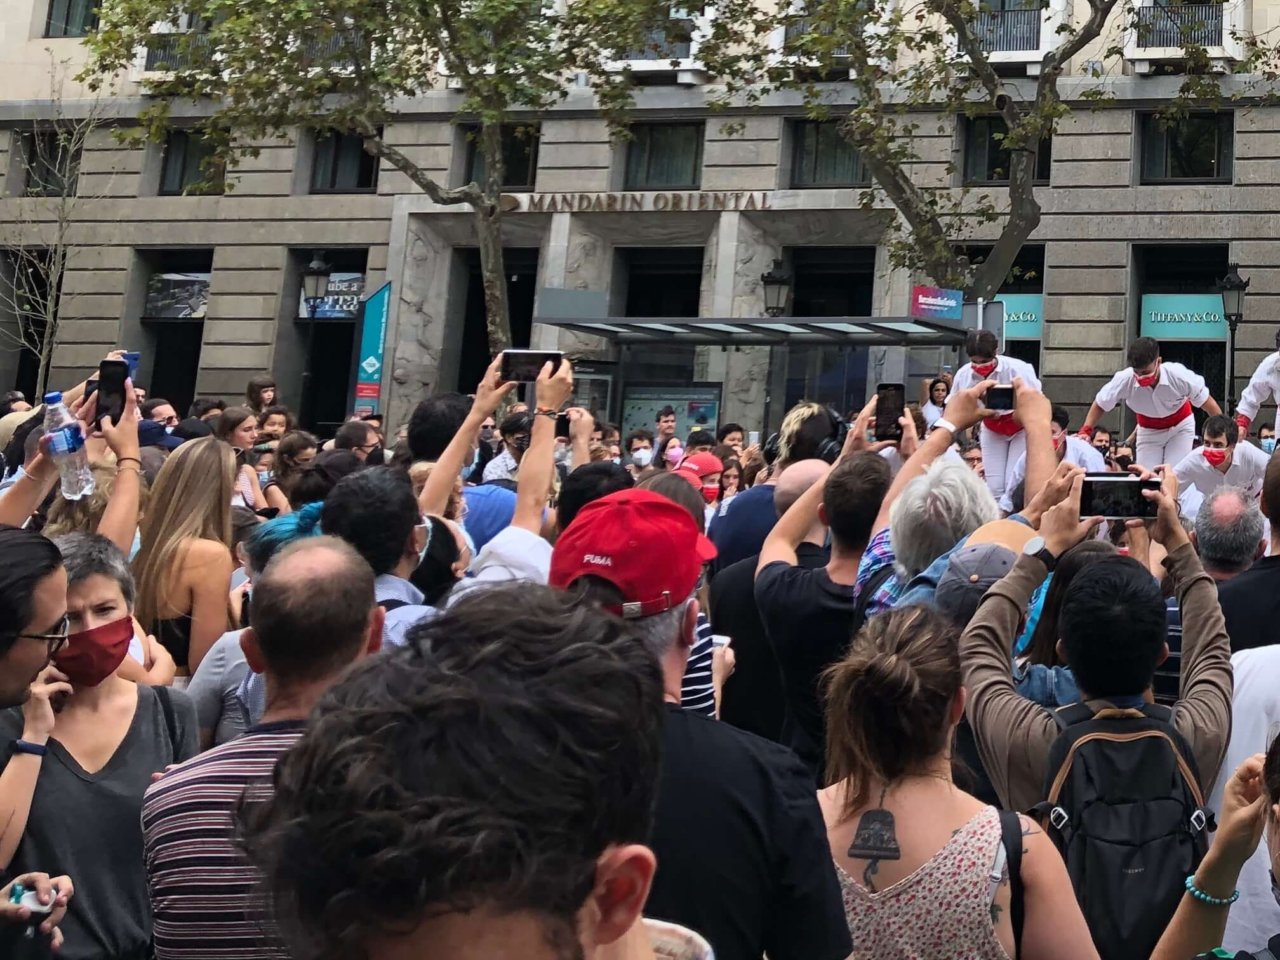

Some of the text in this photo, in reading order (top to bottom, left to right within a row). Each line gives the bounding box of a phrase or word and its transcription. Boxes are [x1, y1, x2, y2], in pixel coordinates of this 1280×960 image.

[527, 192, 771, 211] MANDARIN ORIENTAL
[583, 554, 612, 567] PUMA
